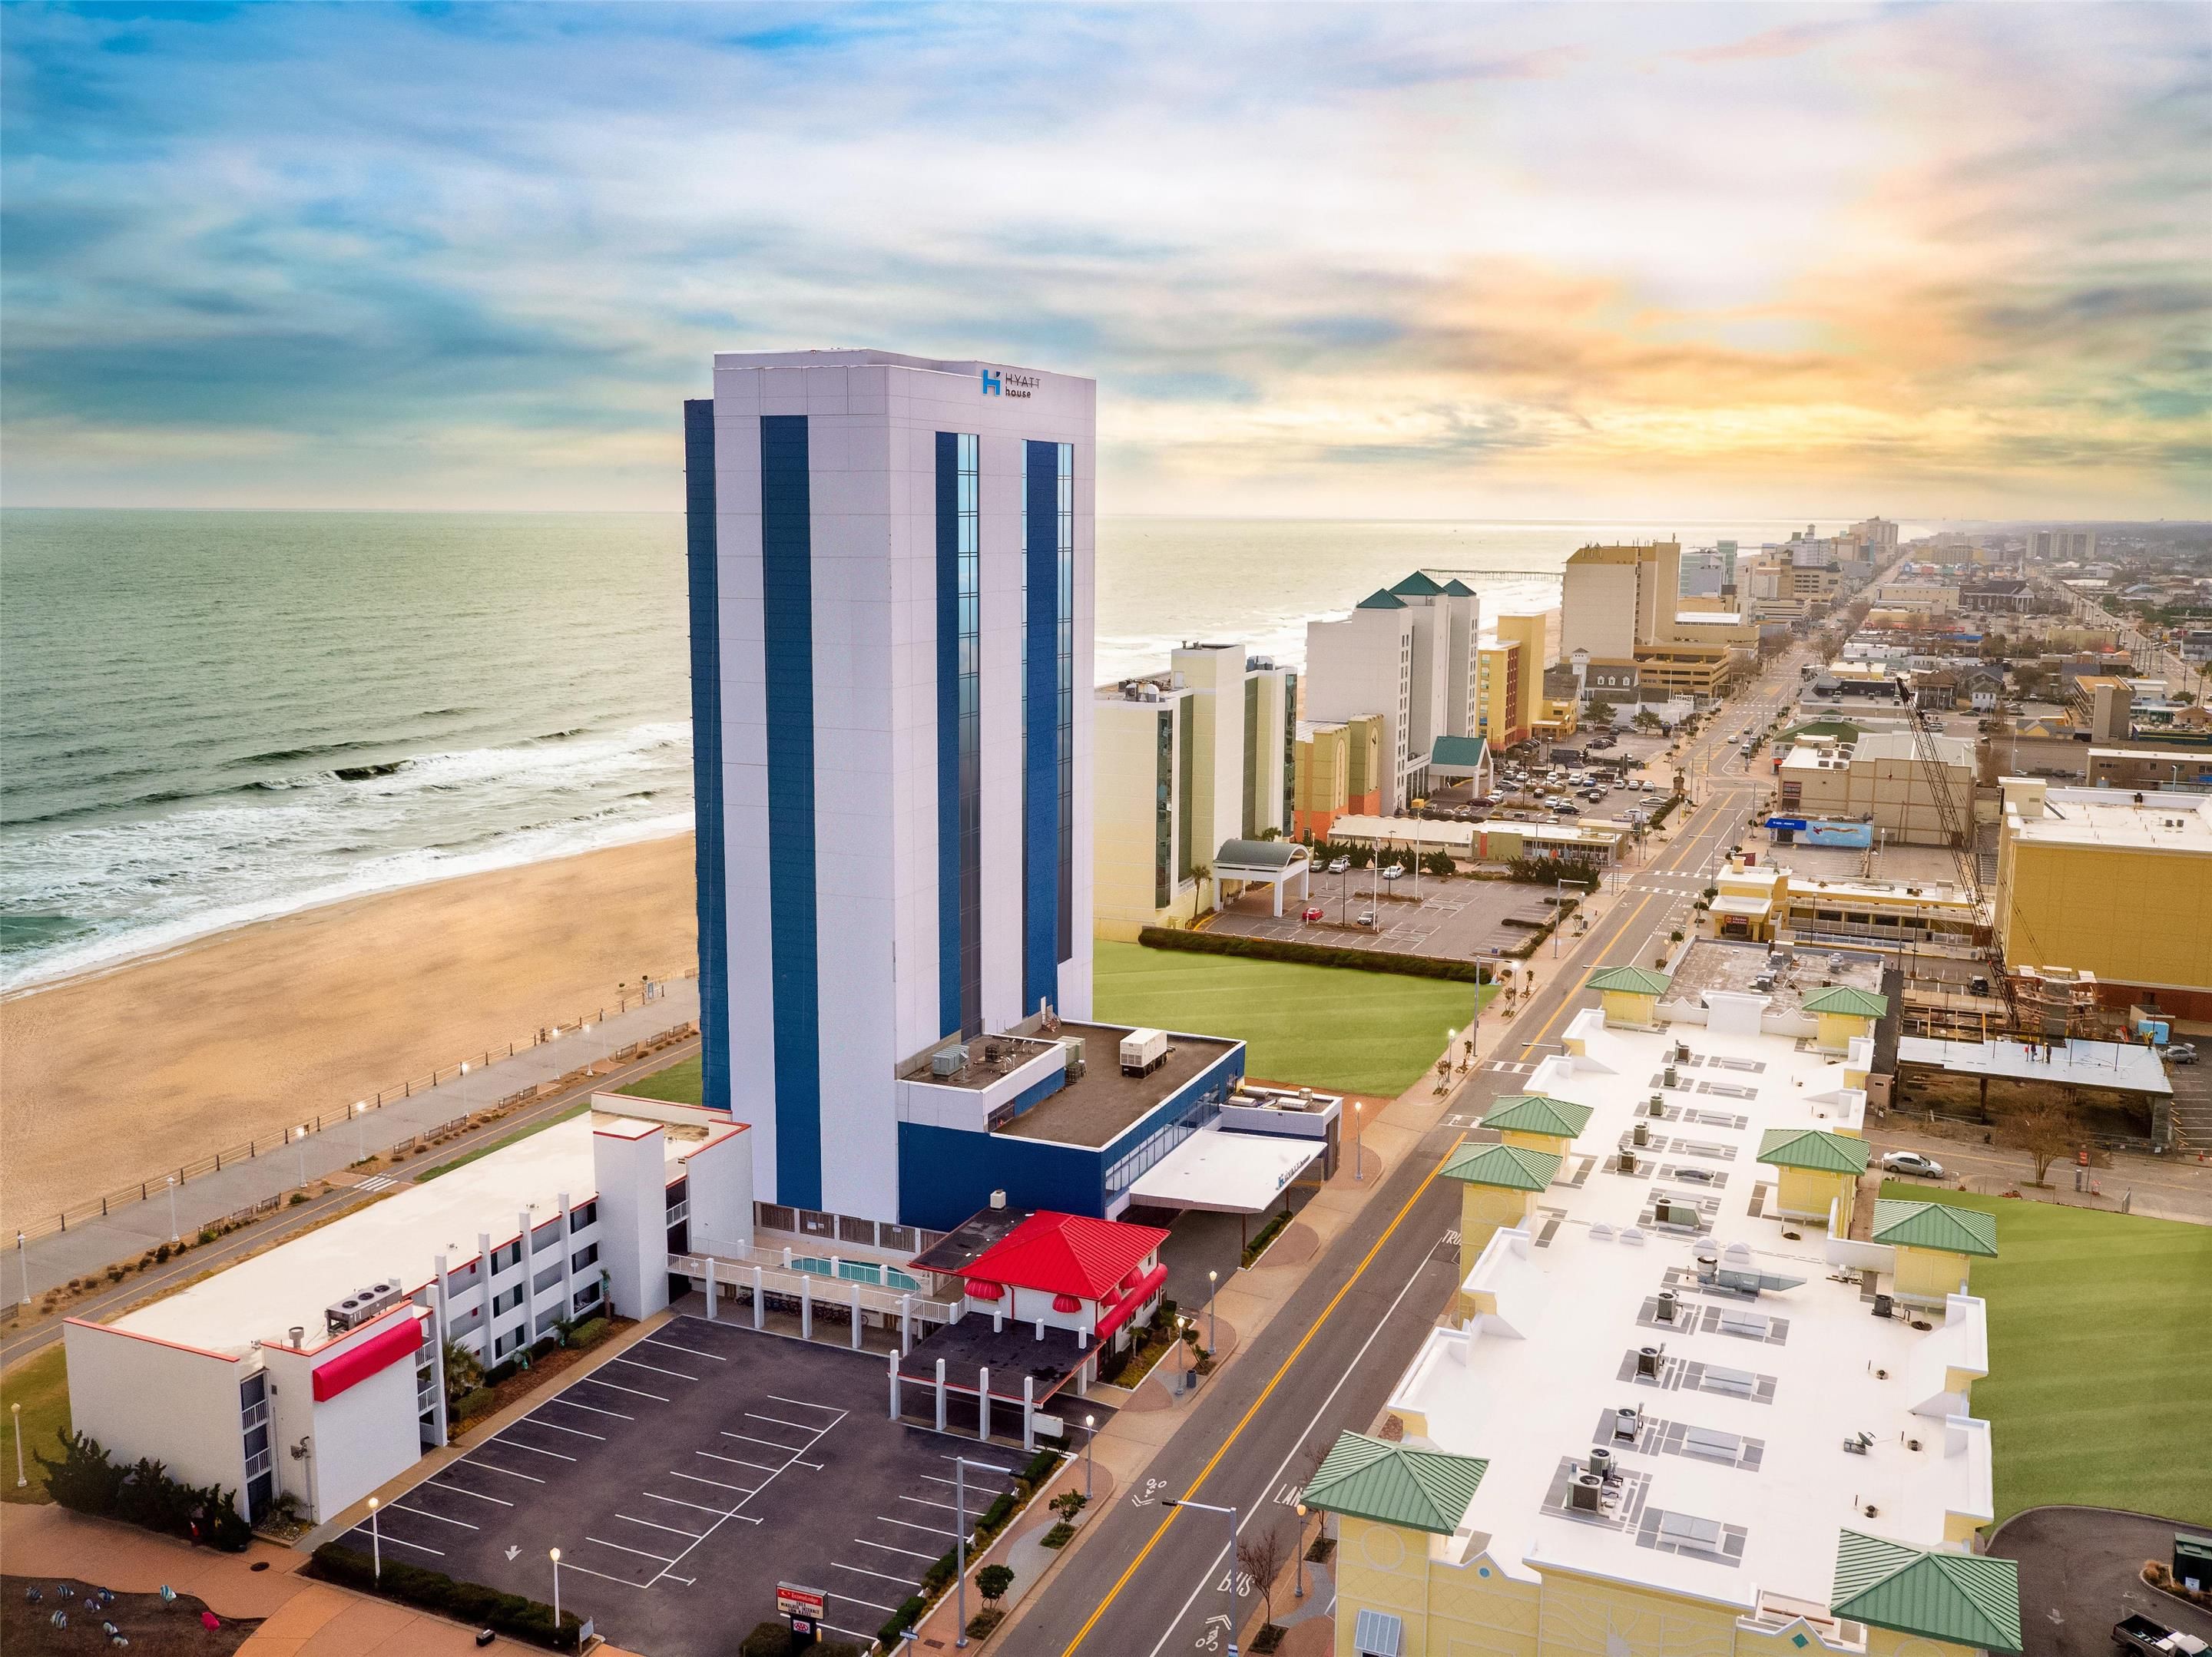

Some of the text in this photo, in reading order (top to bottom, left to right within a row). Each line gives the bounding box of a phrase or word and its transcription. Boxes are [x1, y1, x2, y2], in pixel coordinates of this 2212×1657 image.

[1005, 372, 1041, 389] HYATT
[1005, 386, 1031, 398] house
[1273, 1483, 1303, 1507] LAN
[1217, 1569, 1256, 1597] BUS
